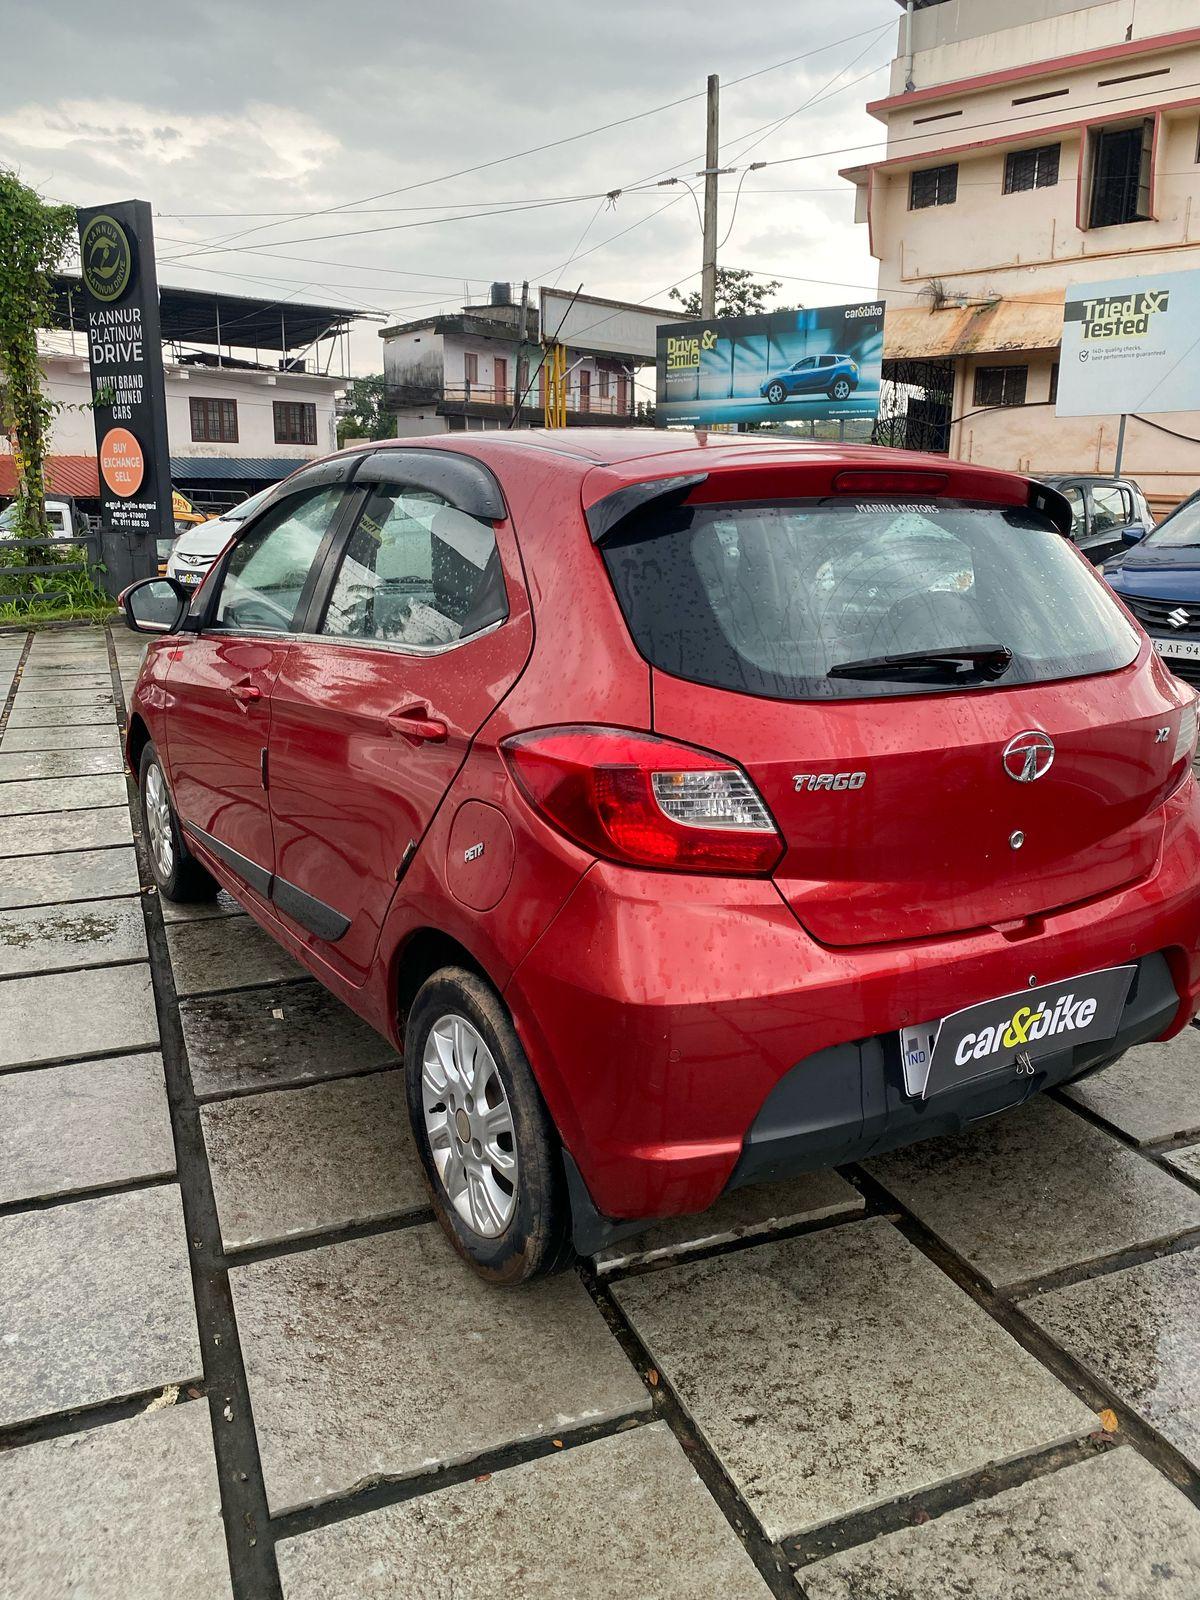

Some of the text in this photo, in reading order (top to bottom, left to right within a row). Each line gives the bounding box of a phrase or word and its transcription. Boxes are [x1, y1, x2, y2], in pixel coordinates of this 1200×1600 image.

[87, 224, 118, 247] KANNUR
[87, 260, 126, 295] PLATINUM DRIVE
[1082, 287, 1169, 321] Tried &
[89, 308, 141, 326] KANNUR
[845, 306, 883, 319] car&bike
[90, 325, 143, 344] PLATINUM
[1082, 314, 1149, 339] Tested
[667, 330, 718, 353] Drive &
[92, 341, 144, 364] DRIVE
[667, 352, 699, 367] Smile
[118, 374, 144, 389] BRAND
[116, 390, 142, 405] OWNED
[112, 405, 132, 420] CARS
[113, 443, 127, 454] BUY
[103, 456, 141, 468] EXCHANGE
[114, 471, 132, 482] SELL
[855, 504, 940, 514] MARINA MOTORS
[1167, 644, 1182, 653] AF
[1186, 645, 1199, 655] 94
[1154, 726, 1171, 744] XZ
[792, 771, 867, 792] TIAGO
[955, 993, 1098, 1066] car&bike
[906, 1051, 926, 1066] IND
